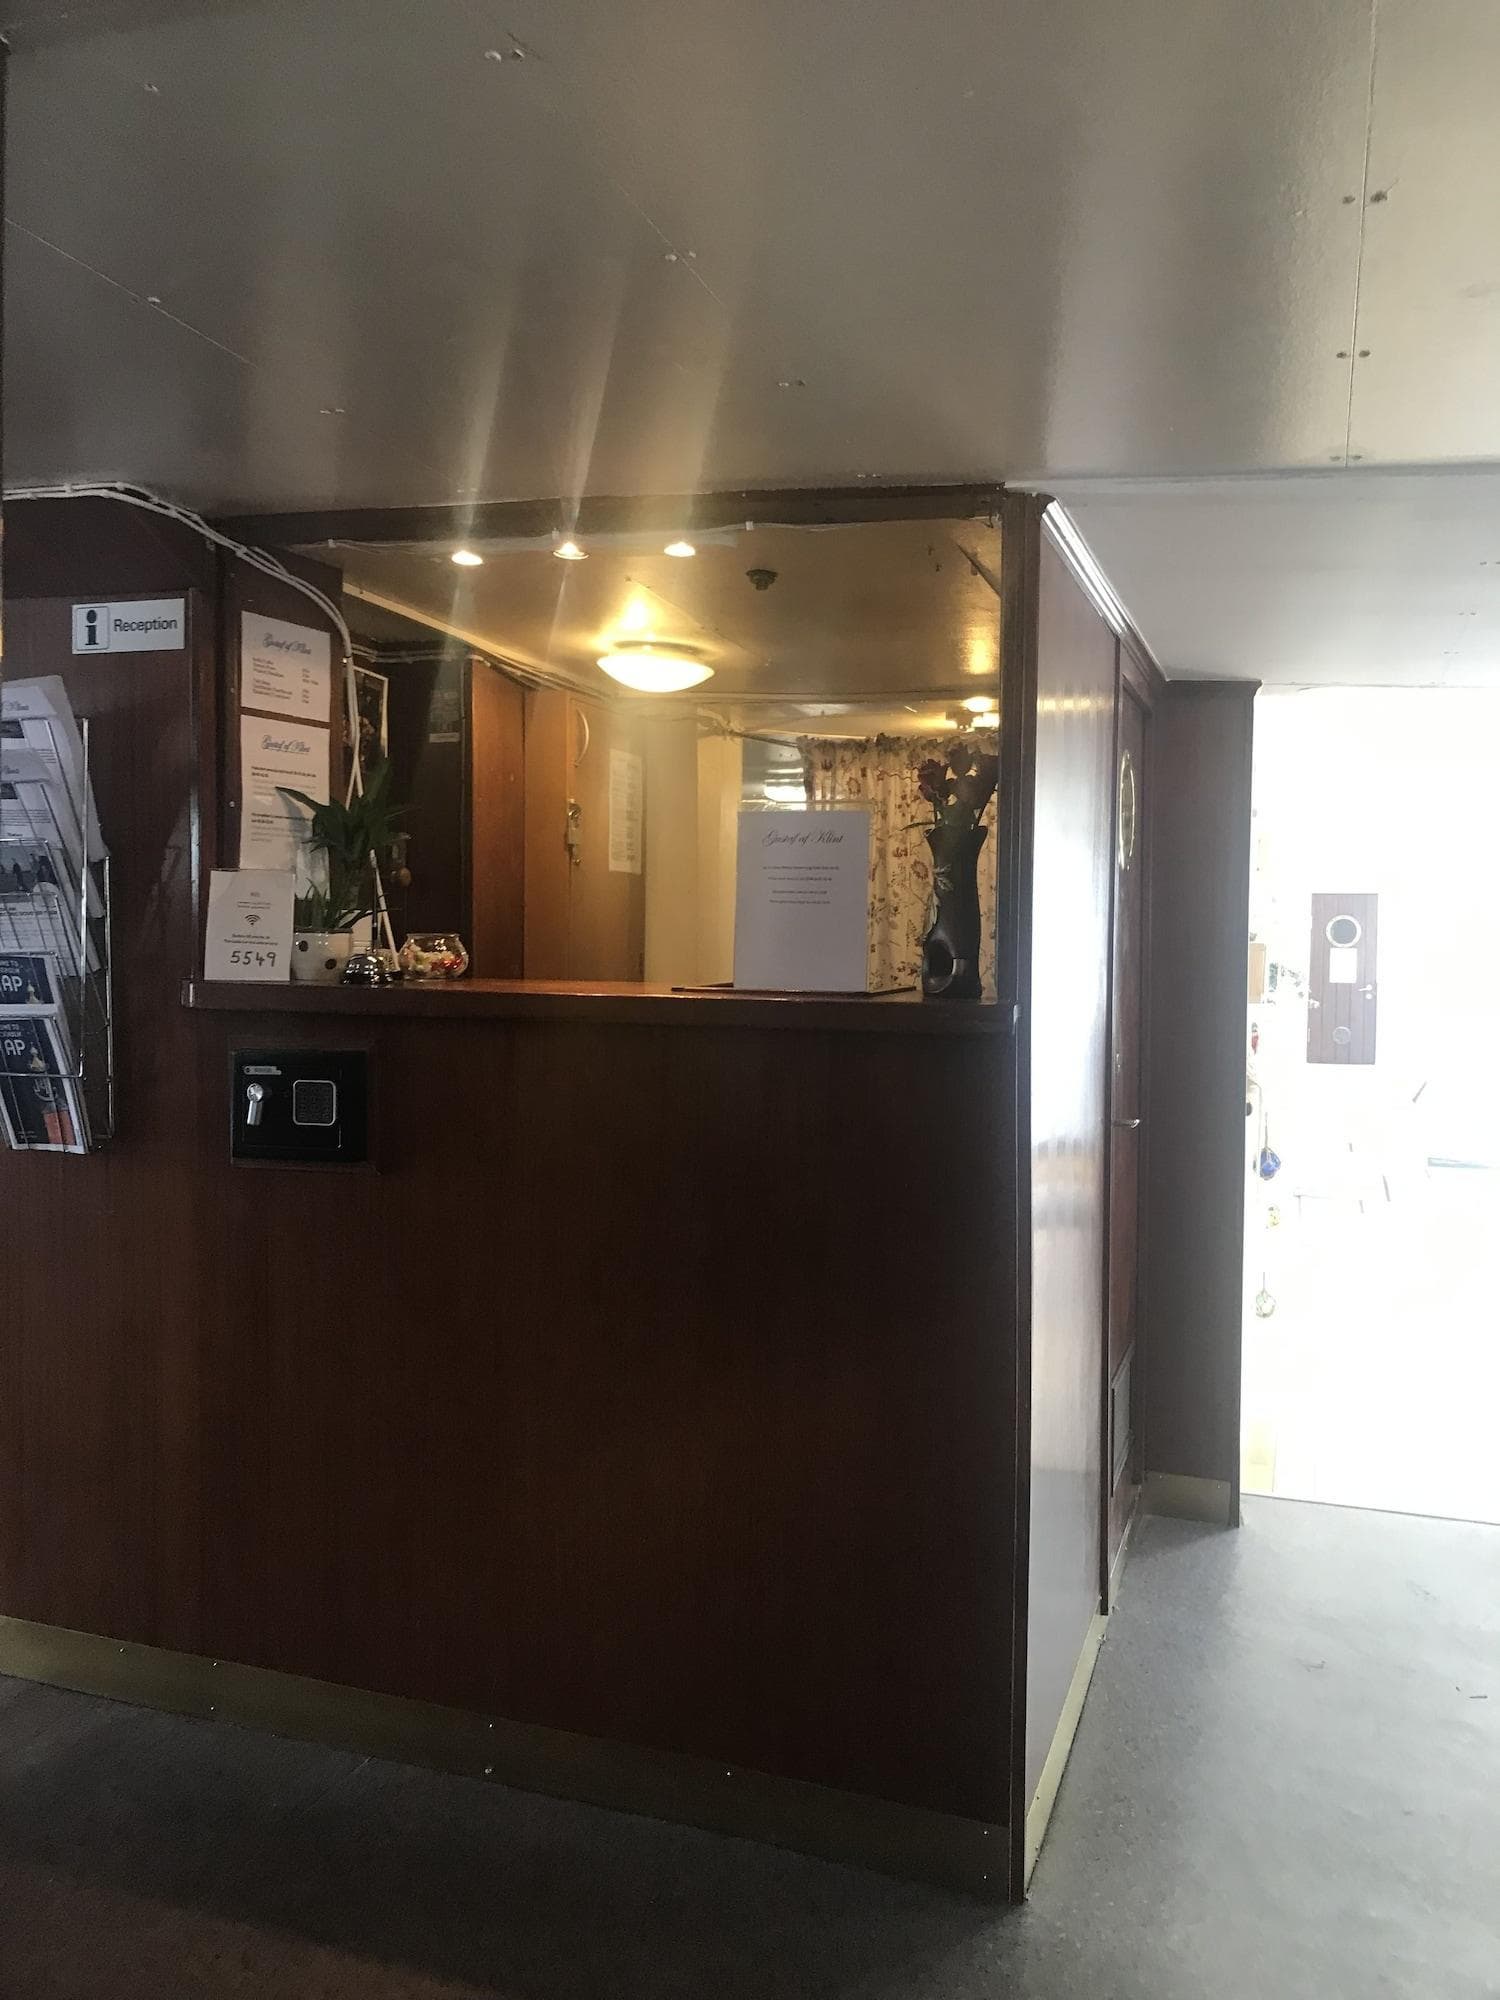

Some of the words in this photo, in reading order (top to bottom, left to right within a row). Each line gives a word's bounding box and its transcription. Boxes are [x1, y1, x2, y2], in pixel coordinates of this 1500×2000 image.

[113, 617, 178, 634] Reception
[230, 950, 277, 968] 5549
[0, 974, 23, 992] AP
[0, 1039, 26, 1056] AP
